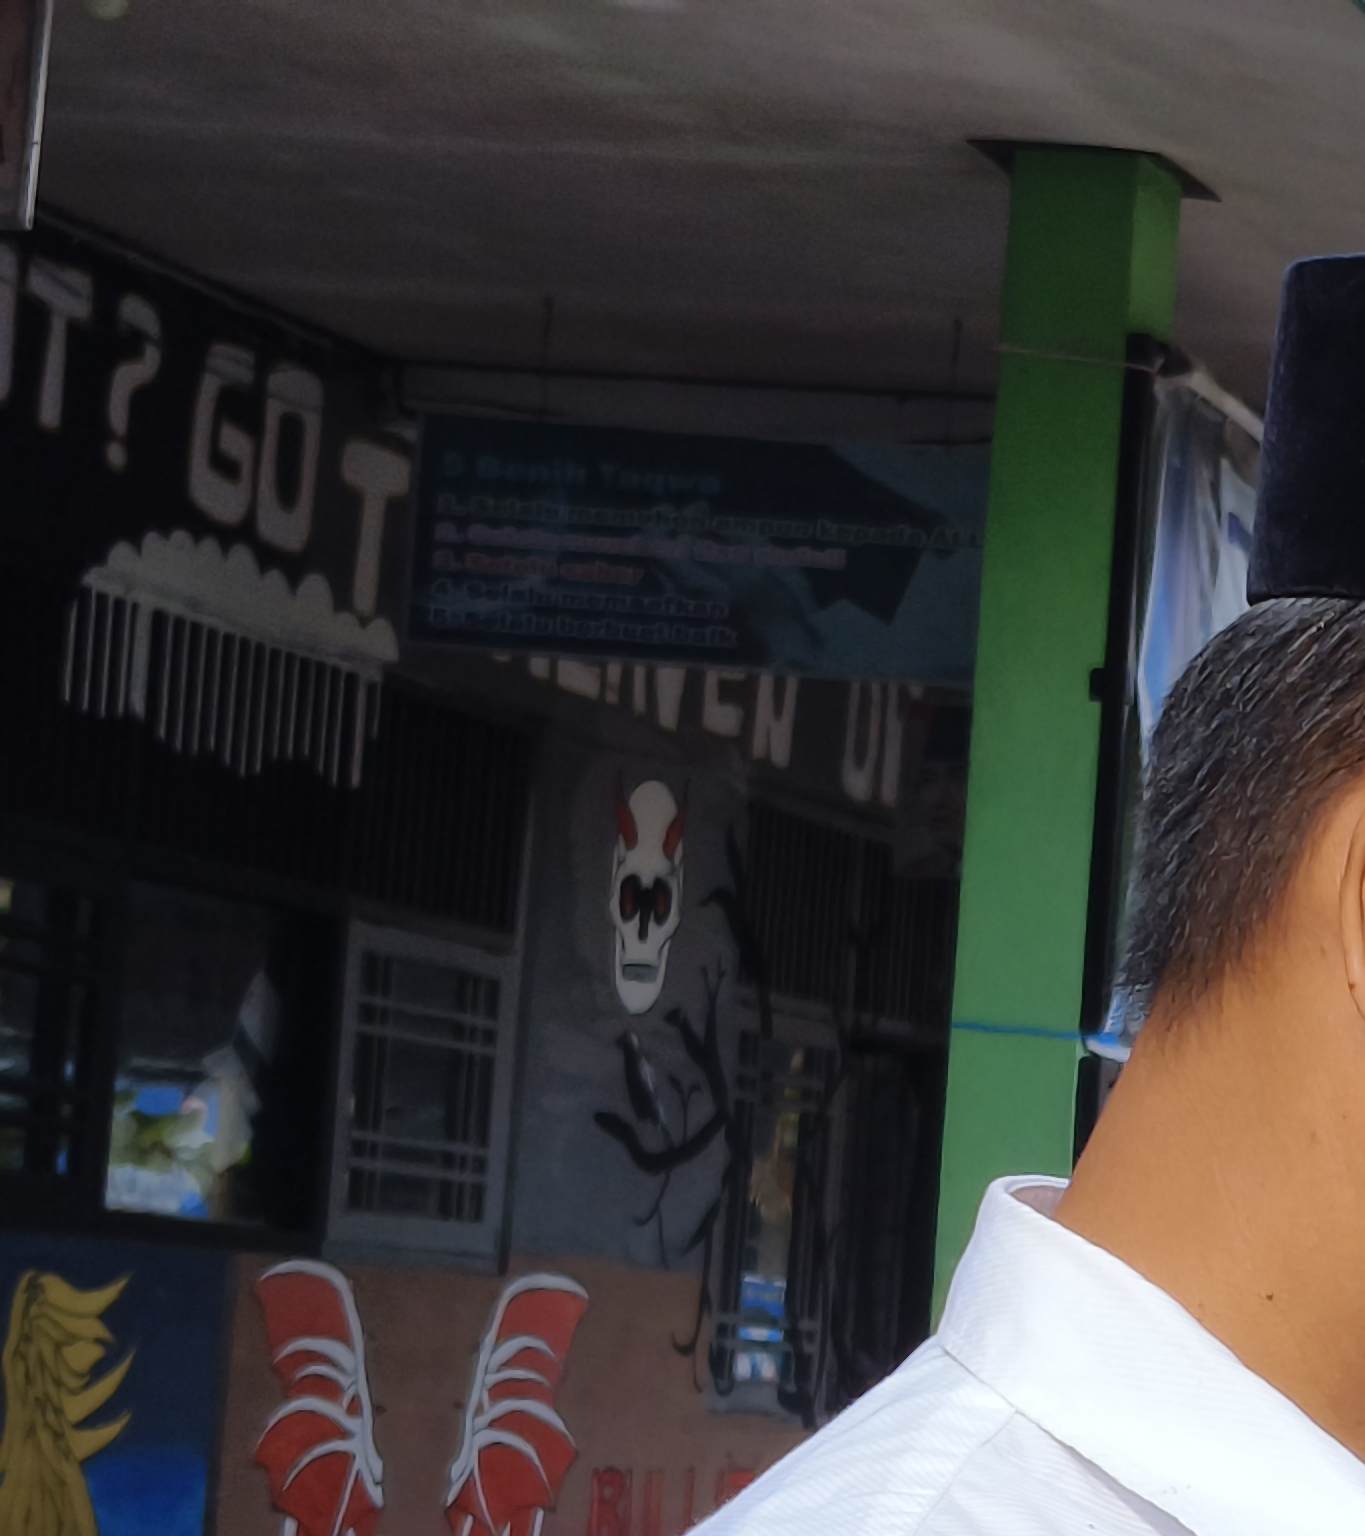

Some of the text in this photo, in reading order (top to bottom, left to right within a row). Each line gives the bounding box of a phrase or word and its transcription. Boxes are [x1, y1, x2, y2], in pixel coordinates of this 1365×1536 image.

[187, 340, 325, 554] GO
[476, 454, 586, 487] Benih
[601, 463, 720, 496] Taqwa
[816, 519, 924, 548] kepada
